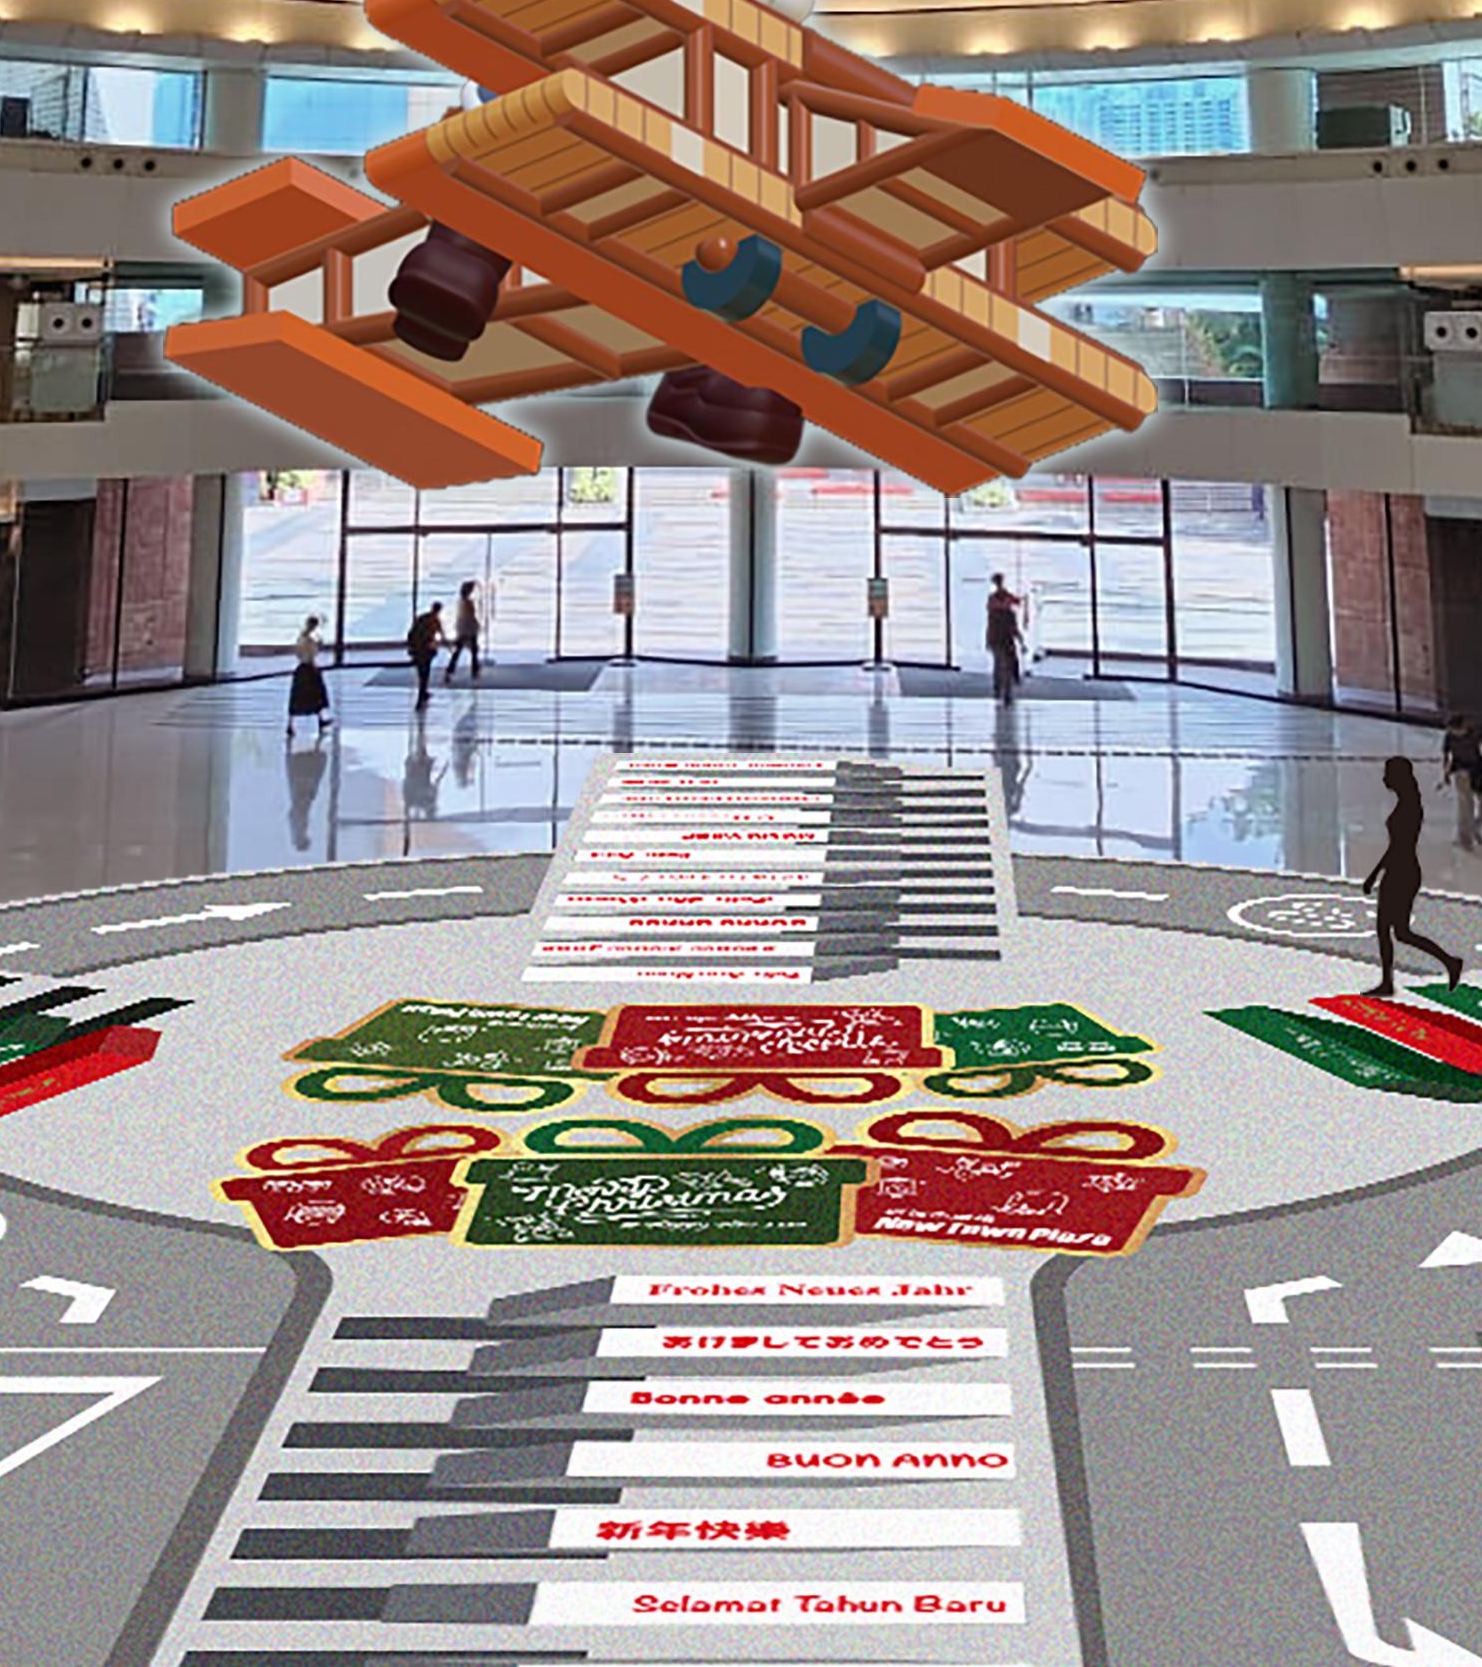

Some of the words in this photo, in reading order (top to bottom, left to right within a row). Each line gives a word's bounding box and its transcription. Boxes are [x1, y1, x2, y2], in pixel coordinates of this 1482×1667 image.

[648, 1282, 766, 1297] Frohes
[778, 1283, 881, 1297] Neues
[890, 1283, 972, 1297] Jahr
[630, 1391, 751, 1406] Bonne
[595, 1519, 792, 1542] 新年快樂
[632, 1594, 782, 1614] Selamat
[794, 1594, 904, 1614] Tahun
[913, 1594, 1007, 1614] Baru
